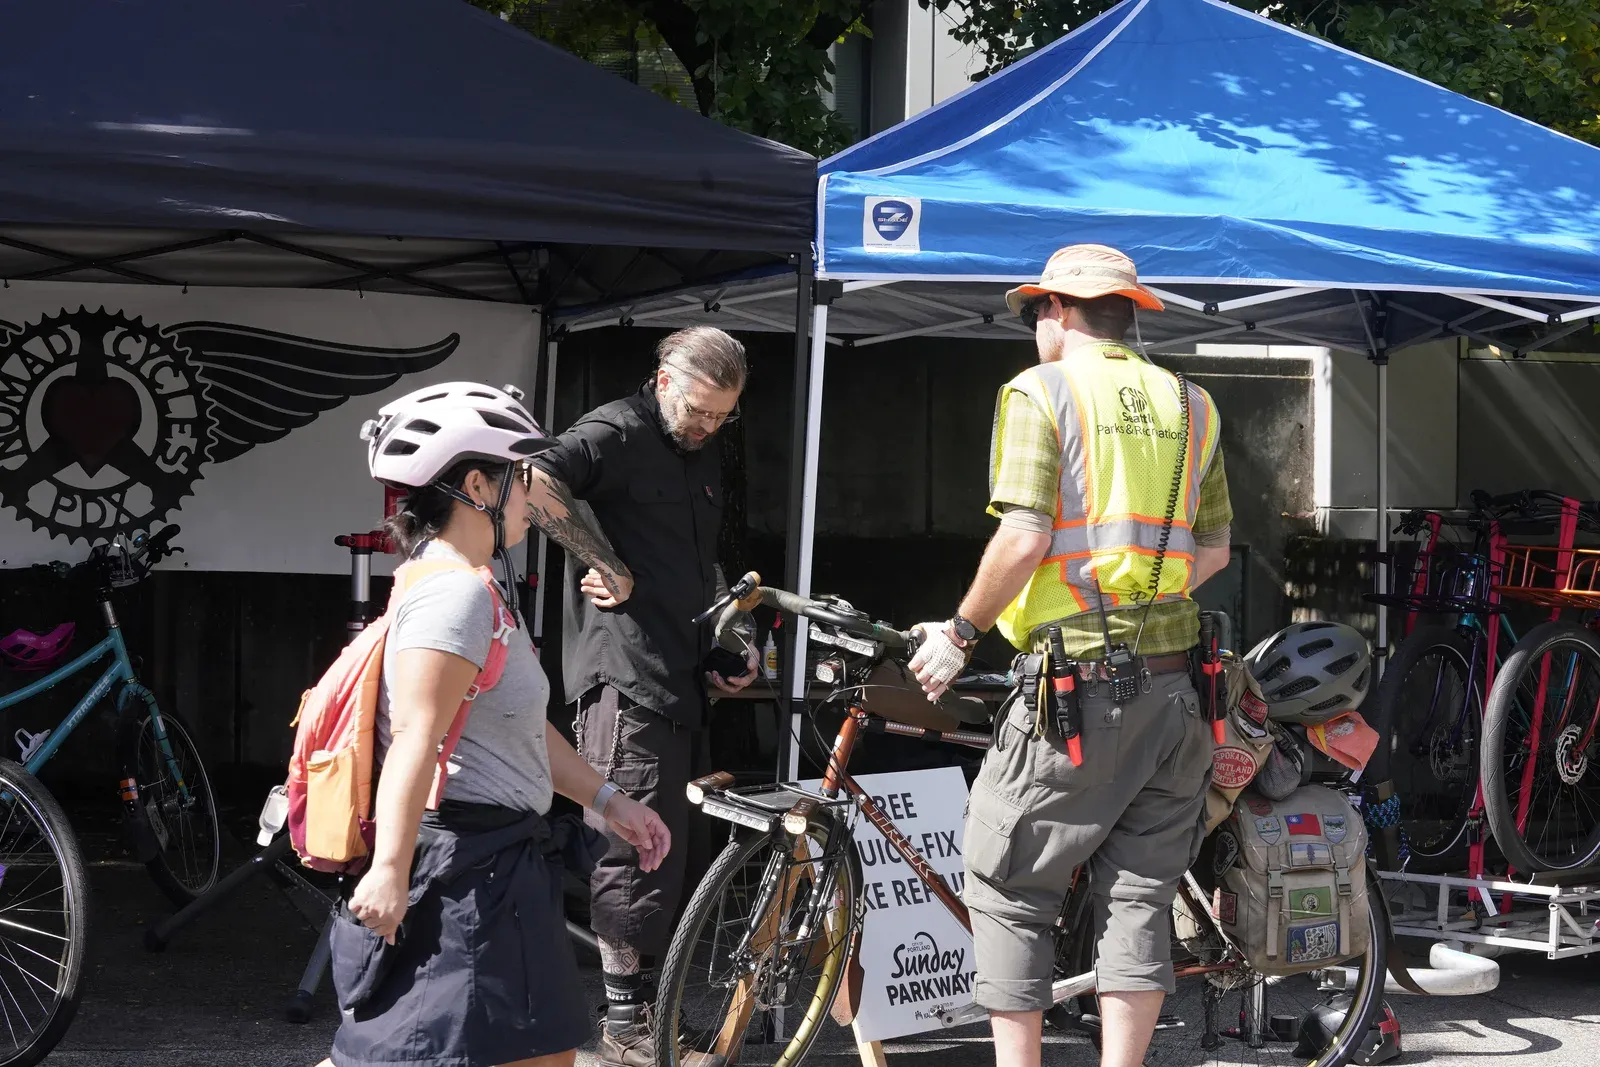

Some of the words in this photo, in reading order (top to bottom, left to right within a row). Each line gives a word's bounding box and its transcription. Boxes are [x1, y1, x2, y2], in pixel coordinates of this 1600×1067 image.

[112, 327, 198, 472] CYCLES
[1096, 422, 1125, 436] Parks
[1125, 423, 1134, 435] &
[56, 488, 132, 526] PDX
[1213, 762, 1253, 775] ORTLAND
[1215, 751, 1250, 766] SPOKANE
[857, 830, 963, 867] UIC-FIX
[870, 803, 936, 880] TREK
[864, 882, 890, 911] KE
[890, 931, 965, 979] Sunday
[907, 944, 931, 953] PORTLAND
